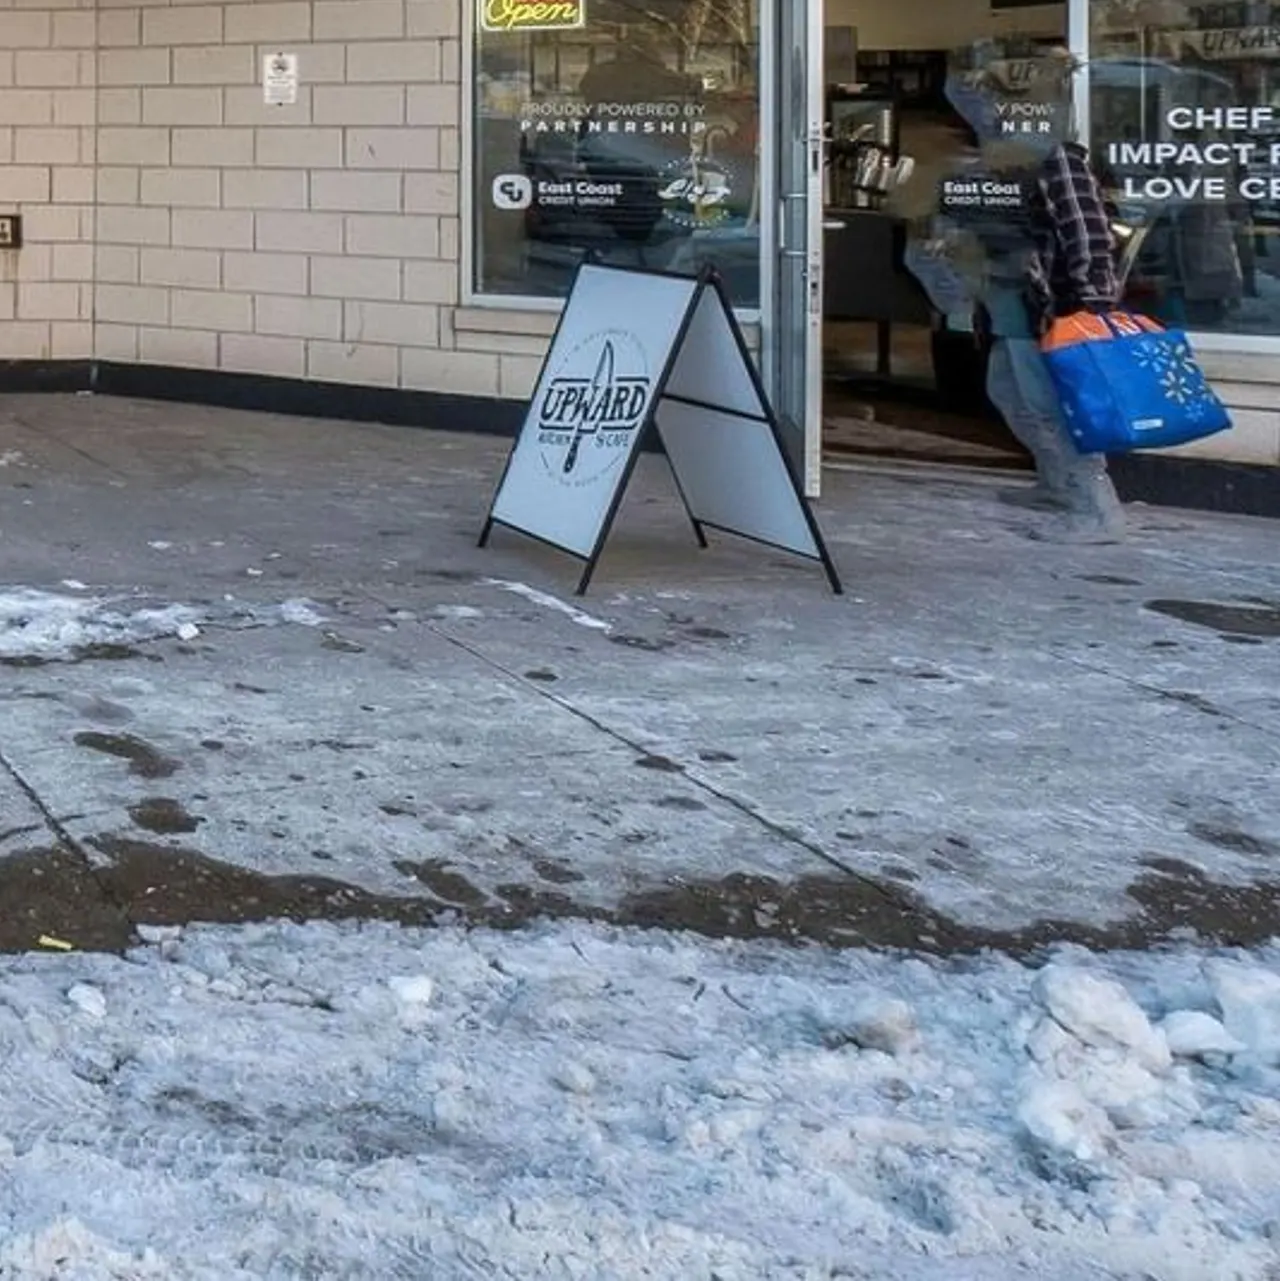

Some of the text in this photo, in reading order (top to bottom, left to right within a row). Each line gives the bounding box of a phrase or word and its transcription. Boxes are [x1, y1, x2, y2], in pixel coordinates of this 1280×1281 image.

[521, 102, 591, 116] PROUDLY
[598, 102, 679, 116] POWERED
[1167, 106, 1273, 130] CHEF
[521, 120, 706, 133] PARTNERSHIP
[1108, 143, 1256, 165] IMPACT
[538, 181, 623, 195] East Coast
[943, 181, 979, 194] East
[1124, 177, 1227, 200] LOVE
[540, 383, 647, 422] UPWARD
